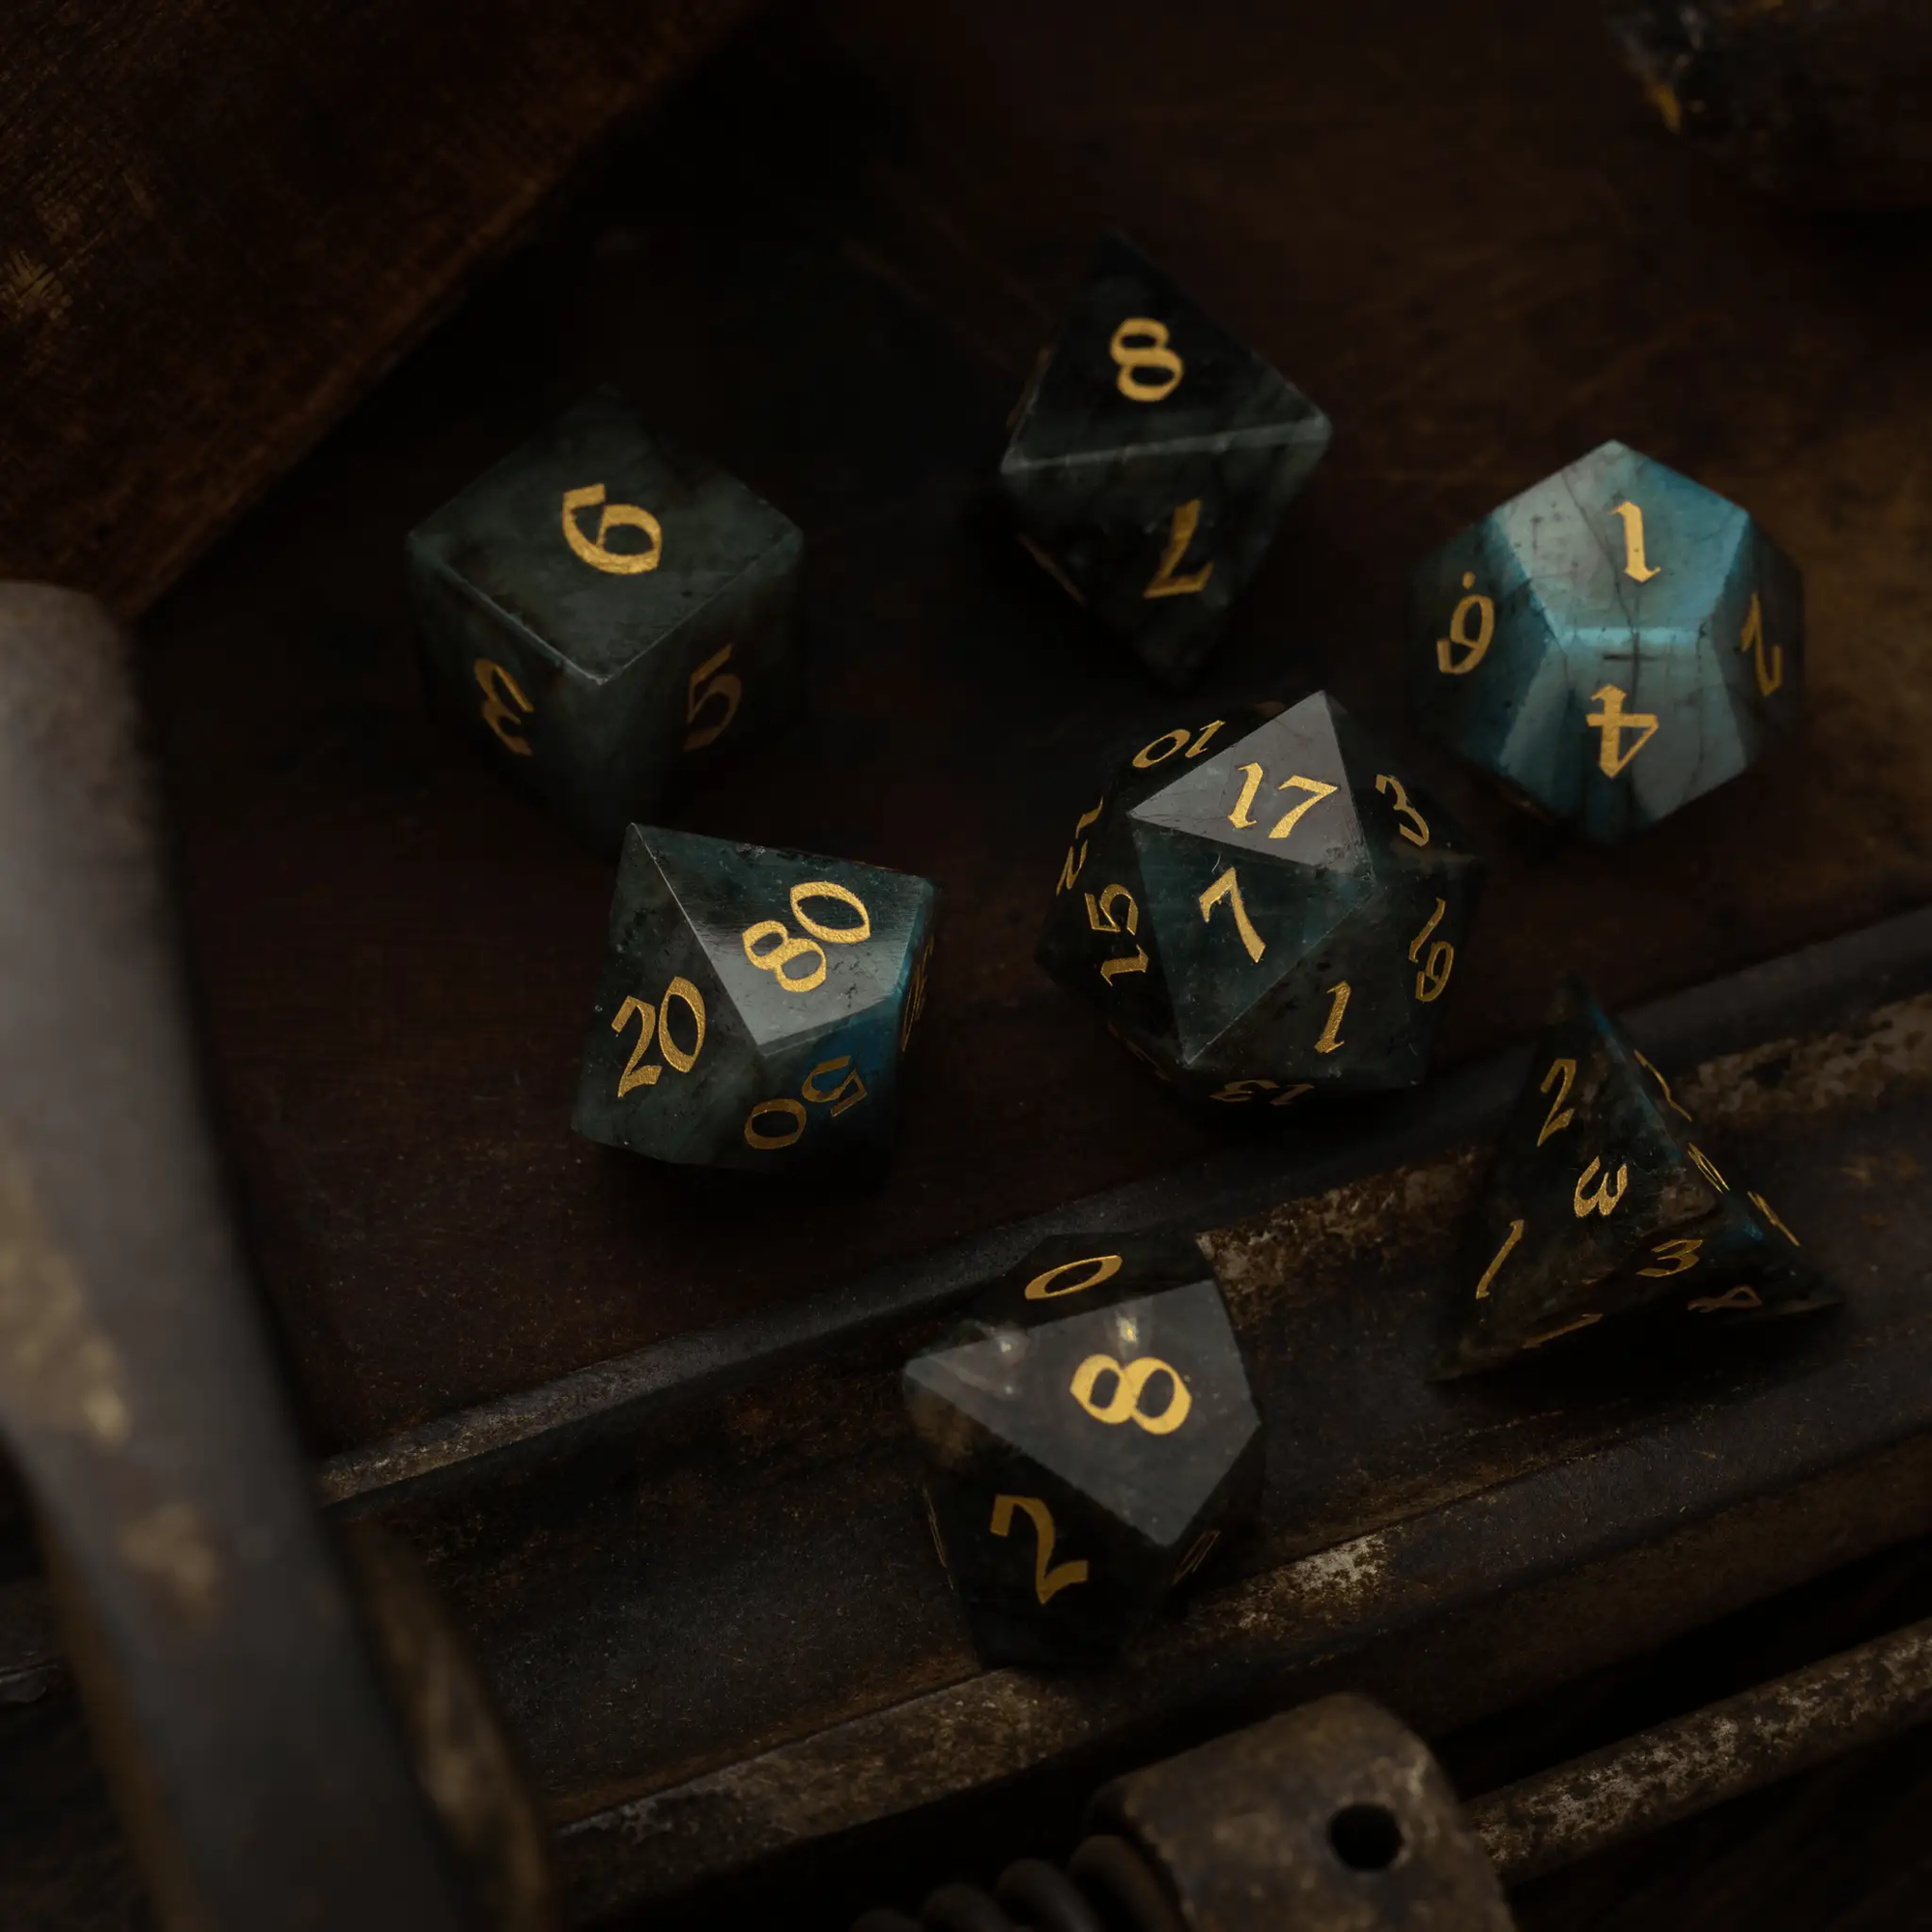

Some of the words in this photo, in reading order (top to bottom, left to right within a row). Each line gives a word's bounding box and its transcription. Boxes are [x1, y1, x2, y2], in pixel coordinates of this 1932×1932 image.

[1109, 317, 1184, 403] 8
[561, 484, 663, 576] 6
[1142, 497, 1214, 601] 7
[1609, 500, 1661, 583] 1
[1741, 596, 1783, 695] 2
[474, 661, 536, 753] 3
[684, 643, 742, 754] 5
[1586, 685, 1659, 778] 4
[1131, 719, 1228, 771] 10
[1227, 762, 1338, 838] 17
[1375, 773, 1431, 851] 3
[742, 881, 870, 992] 80
[1084, 883, 1149, 987] 15
[1198, 867, 1266, 964] 7
[611, 976, 706, 1098] 20
[1314, 980, 1351, 1054] 1
[743, 1056, 867, 1151] 50
[1537, 1057, 1577, 1148] 2
[1573, 1156, 1628, 1219] 3
[1024, 1254, 1123, 1302] 0
[1475, 1219, 1524, 1299] 1
[1636, 1237, 1704, 1278] 3
[1070, 1353, 1192, 1435] 8
[988, 1493, 1091, 1605] 2
